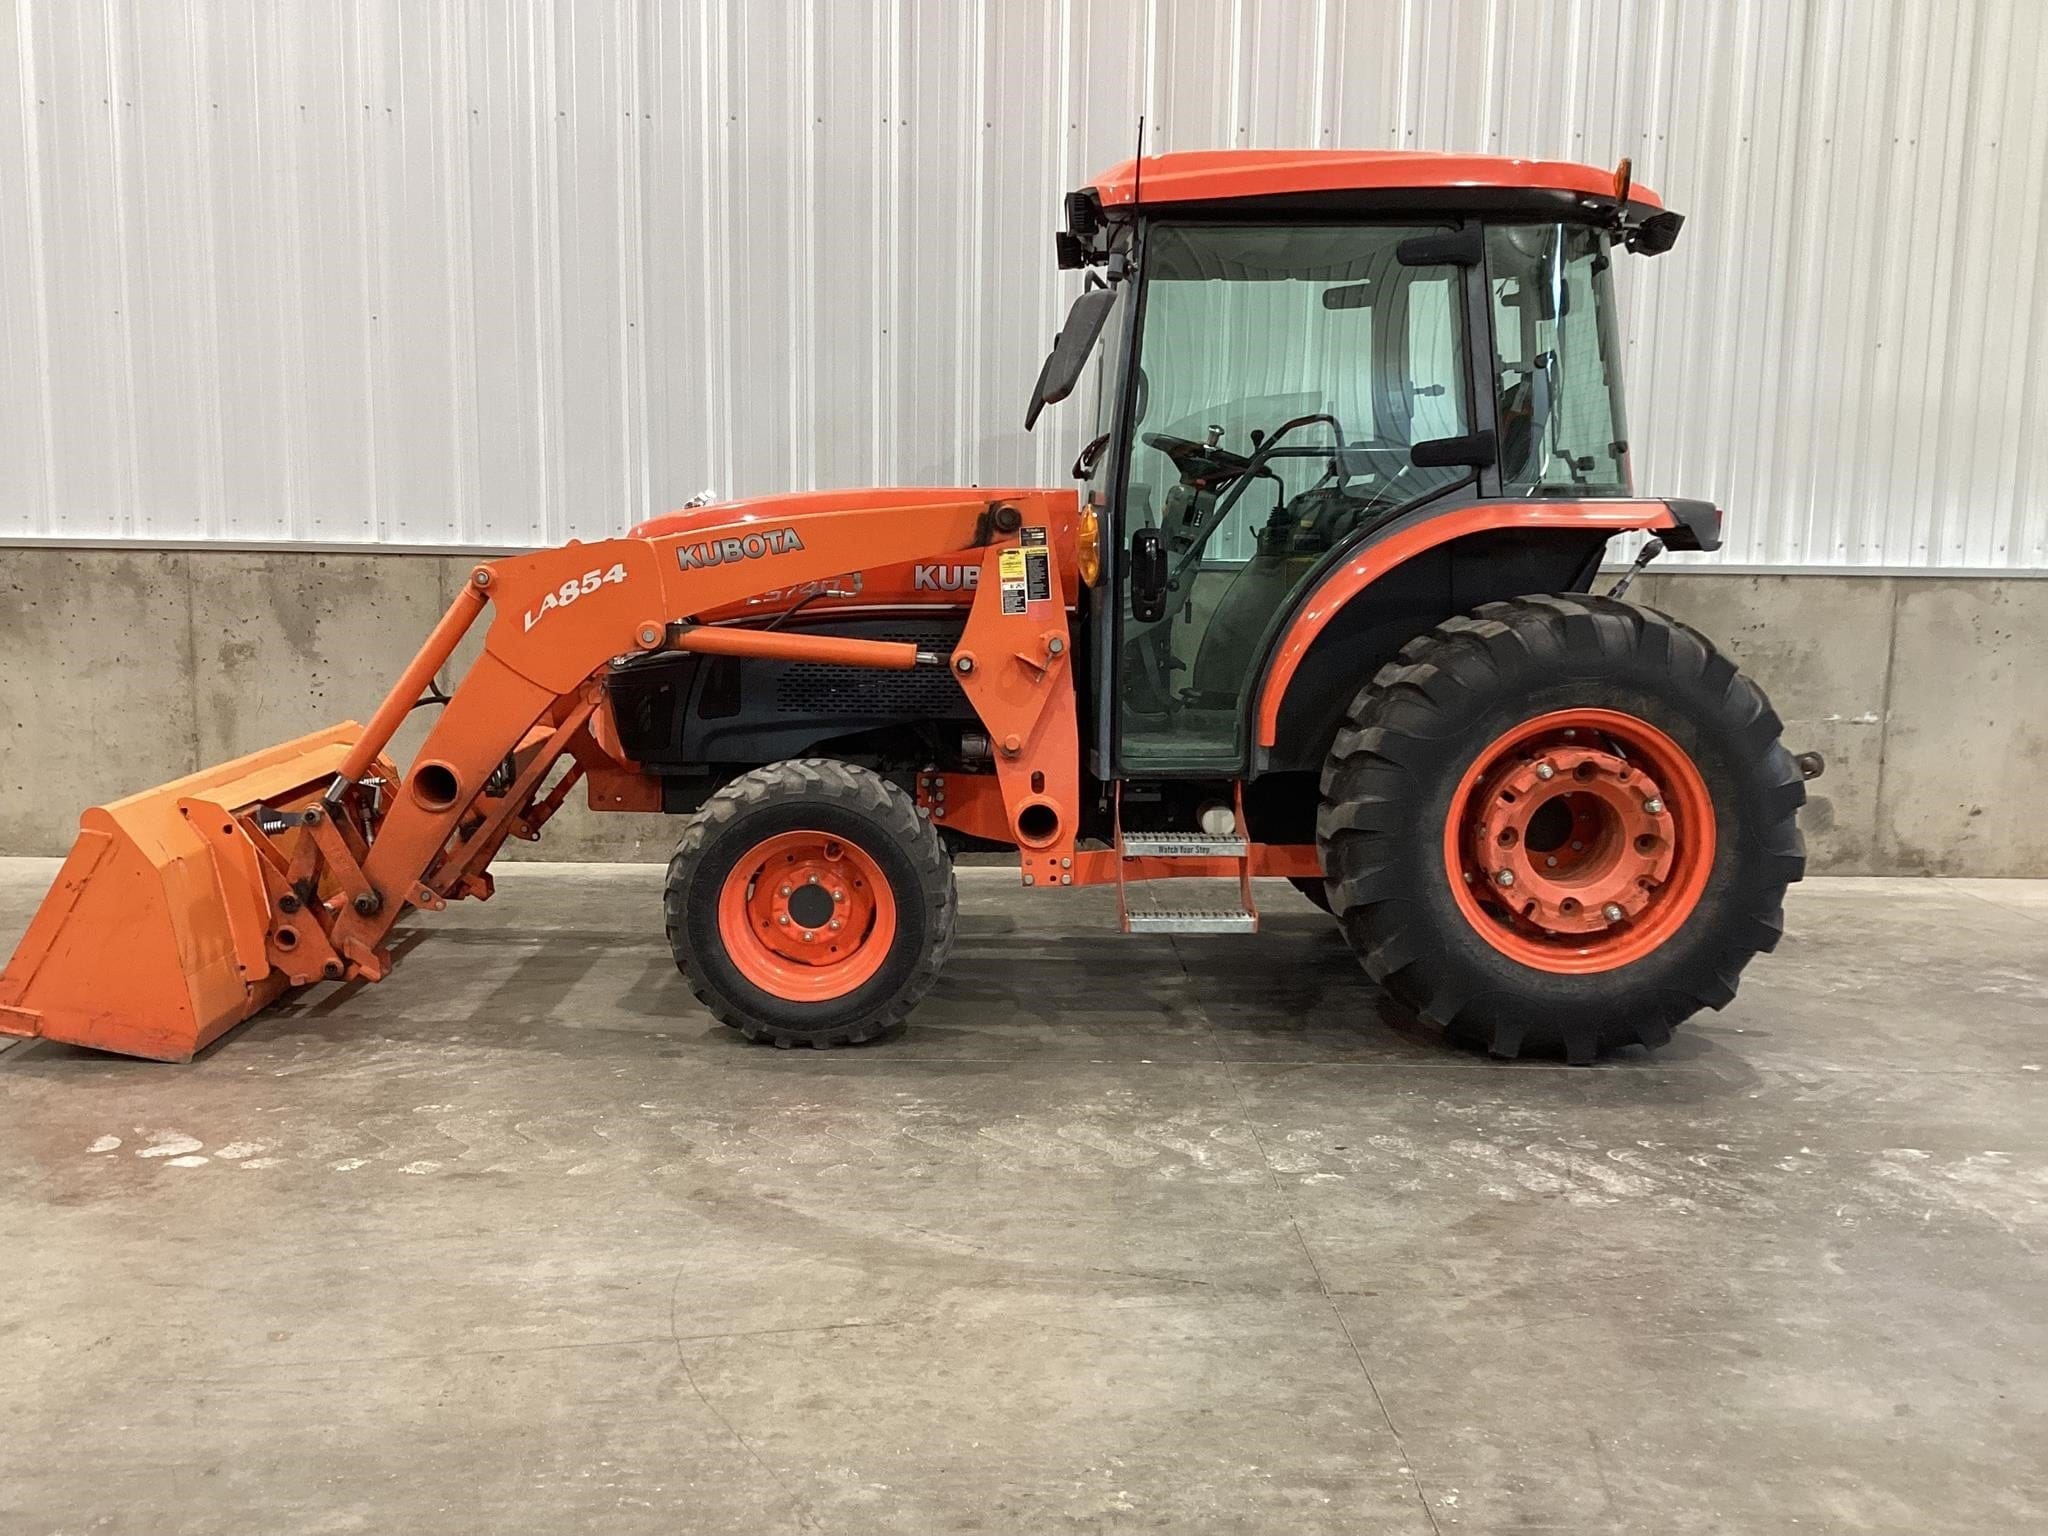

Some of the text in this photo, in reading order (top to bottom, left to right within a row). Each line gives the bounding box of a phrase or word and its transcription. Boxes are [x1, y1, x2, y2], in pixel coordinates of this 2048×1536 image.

[676, 527, 805, 571] KUBOTA
[523, 563, 628, 633] LA854
[1158, 845, 1178, 854] Watch
